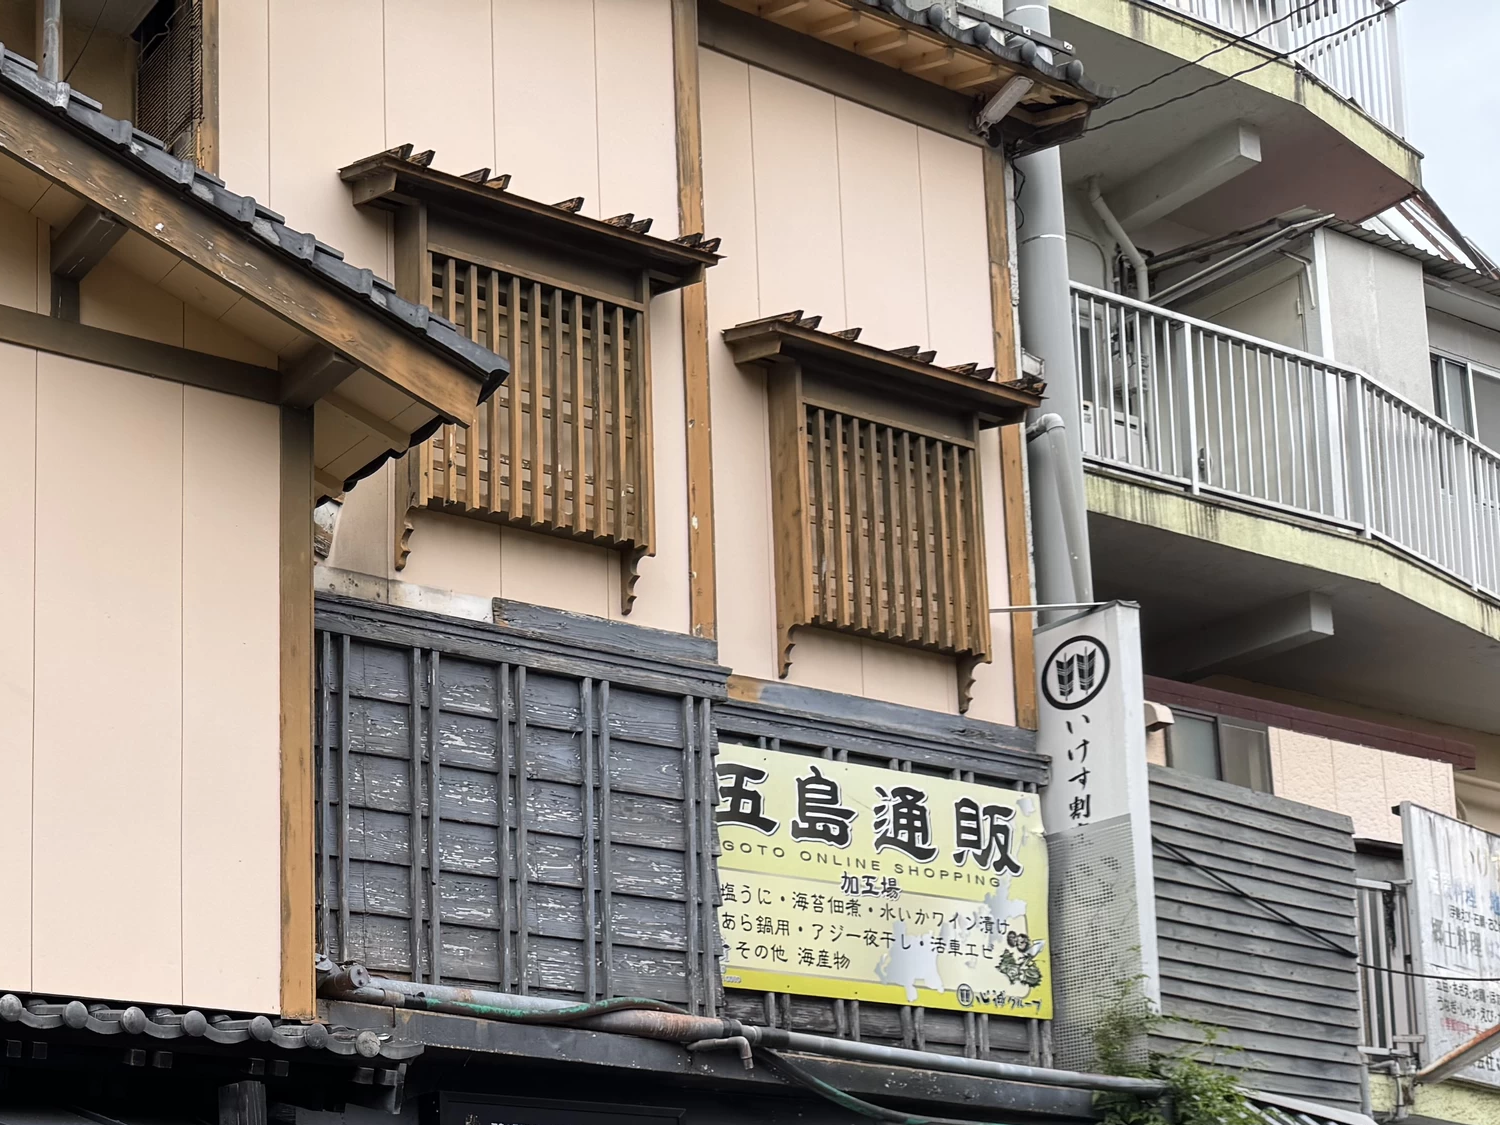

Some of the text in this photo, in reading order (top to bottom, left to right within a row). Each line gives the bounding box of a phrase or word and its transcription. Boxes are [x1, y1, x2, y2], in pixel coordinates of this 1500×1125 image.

[1066, 714, 1091, 828] いけす割
[717, 764, 1023, 875] 五島通販
[722, 840, 1000, 887] GOTO ONLINE SHOPPING
[841, 871, 900, 899] 加工場
[736, 942, 850, 970] その他 海産物
